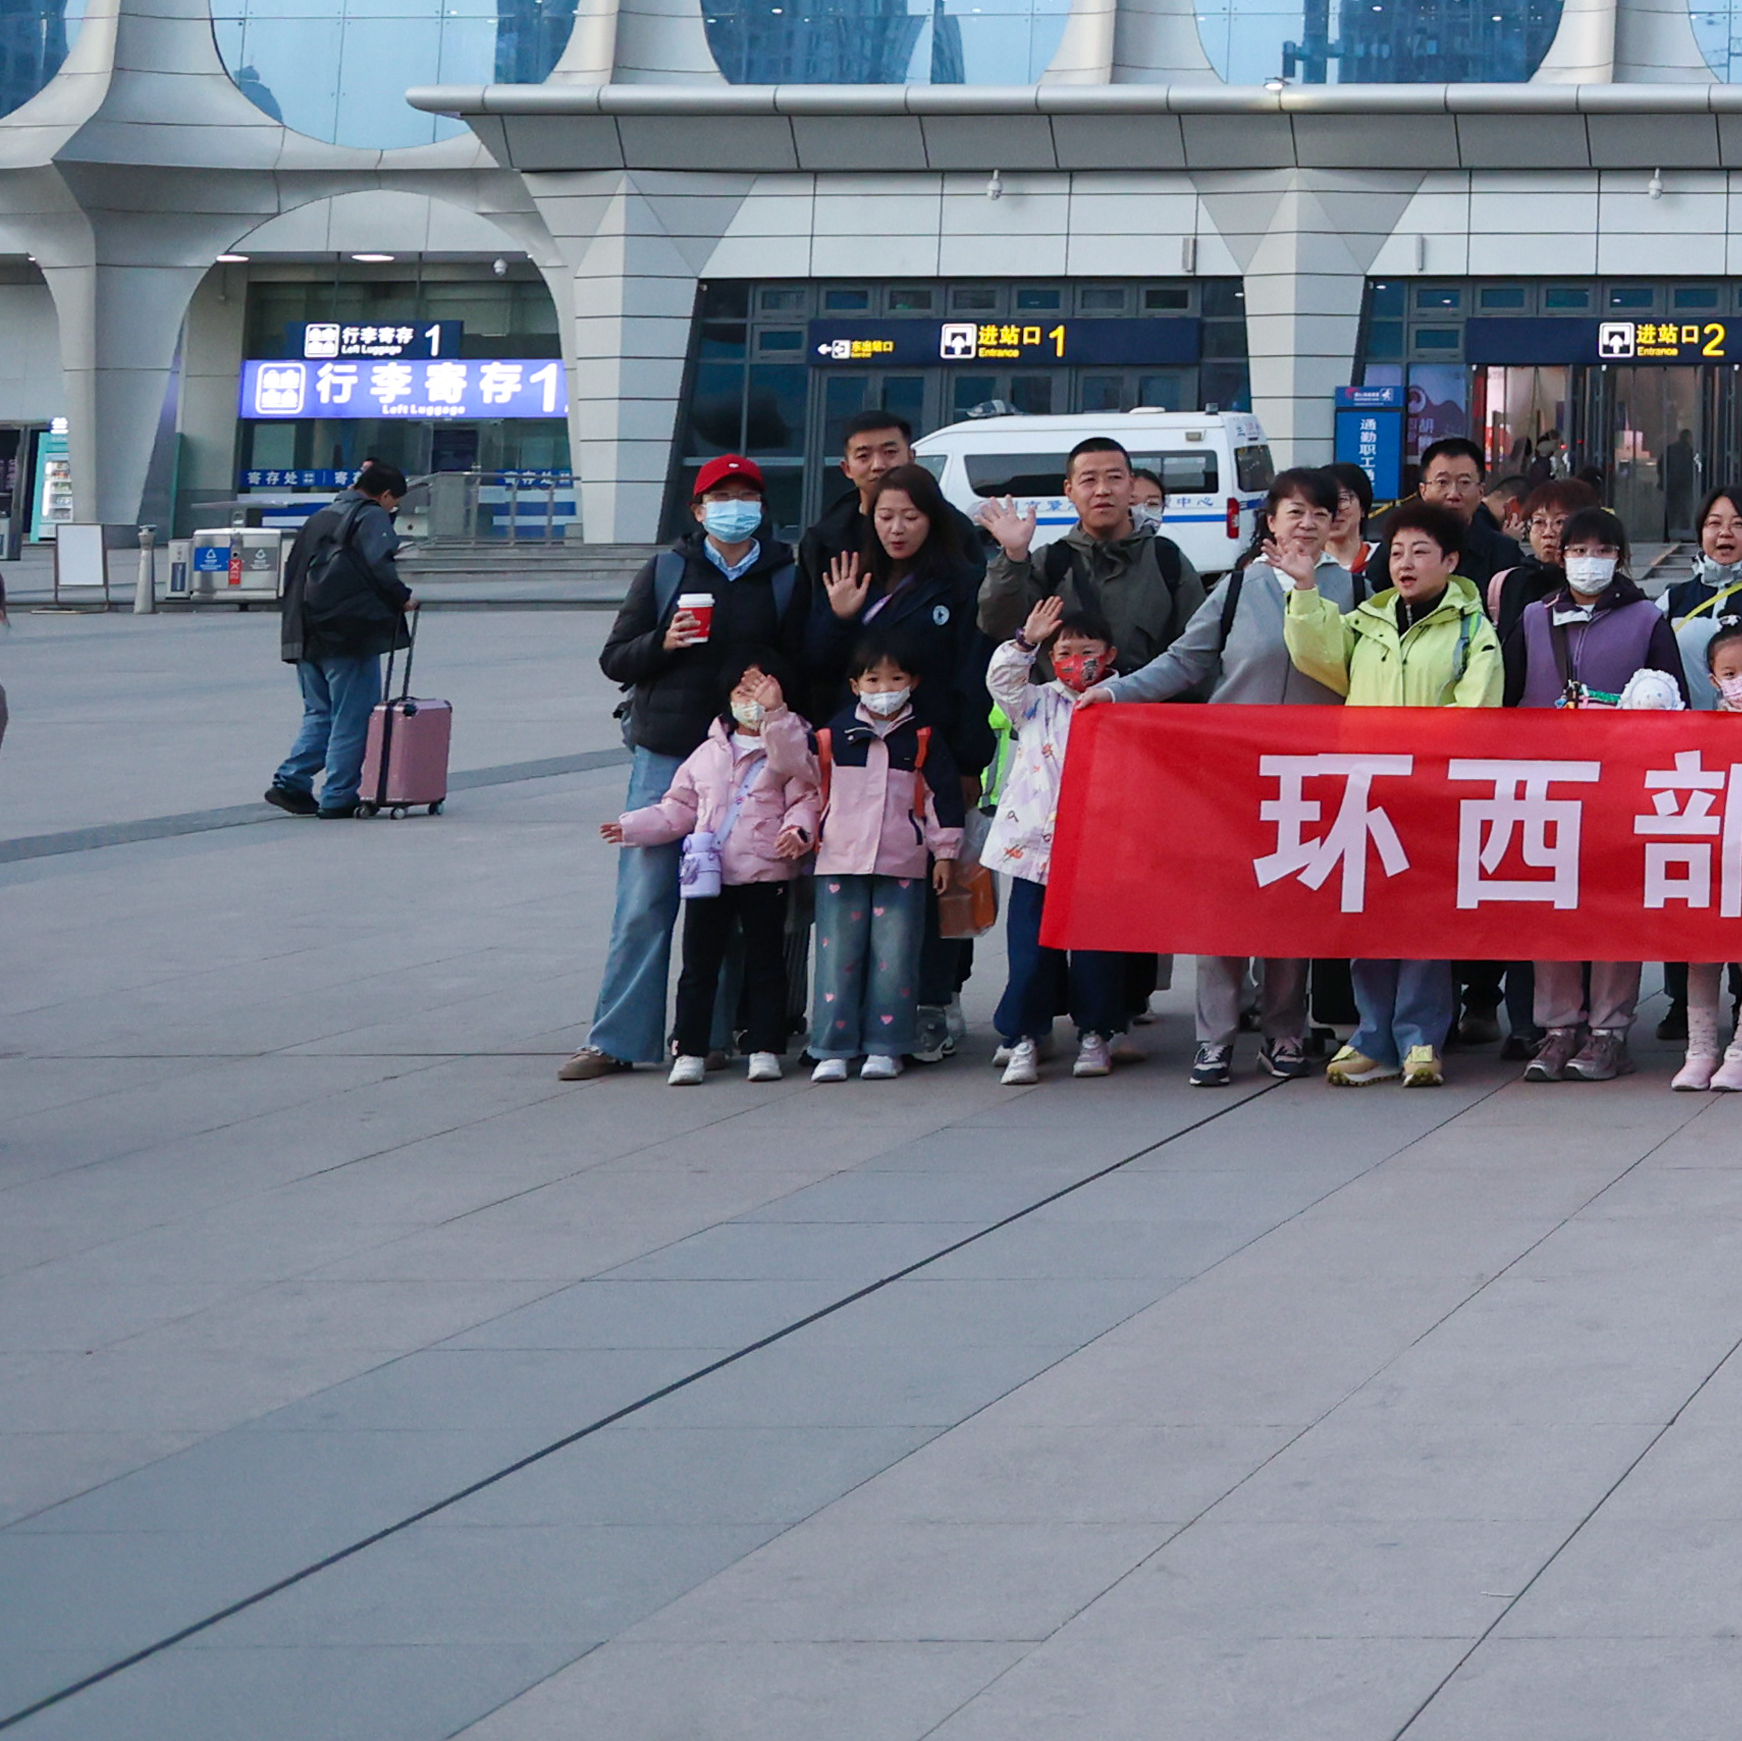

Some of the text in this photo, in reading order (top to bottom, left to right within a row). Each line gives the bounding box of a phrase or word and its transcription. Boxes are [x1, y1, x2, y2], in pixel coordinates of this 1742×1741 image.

[342, 324, 441, 357] 行李寄存 1
[978, 324, 1066, 357] 进站口 1
[1636, 322, 1725, 357] 进站口 2
[341, 345, 402, 356] Left Luggage
[978, 347, 1020, 358] Entrance
[1636, 346, 1679, 357] Entrance
[315, 361, 559, 413] 行李寄存 1
[381, 405, 466, 416] Left Luggage
[247, 470, 299, 486] 寄存处
